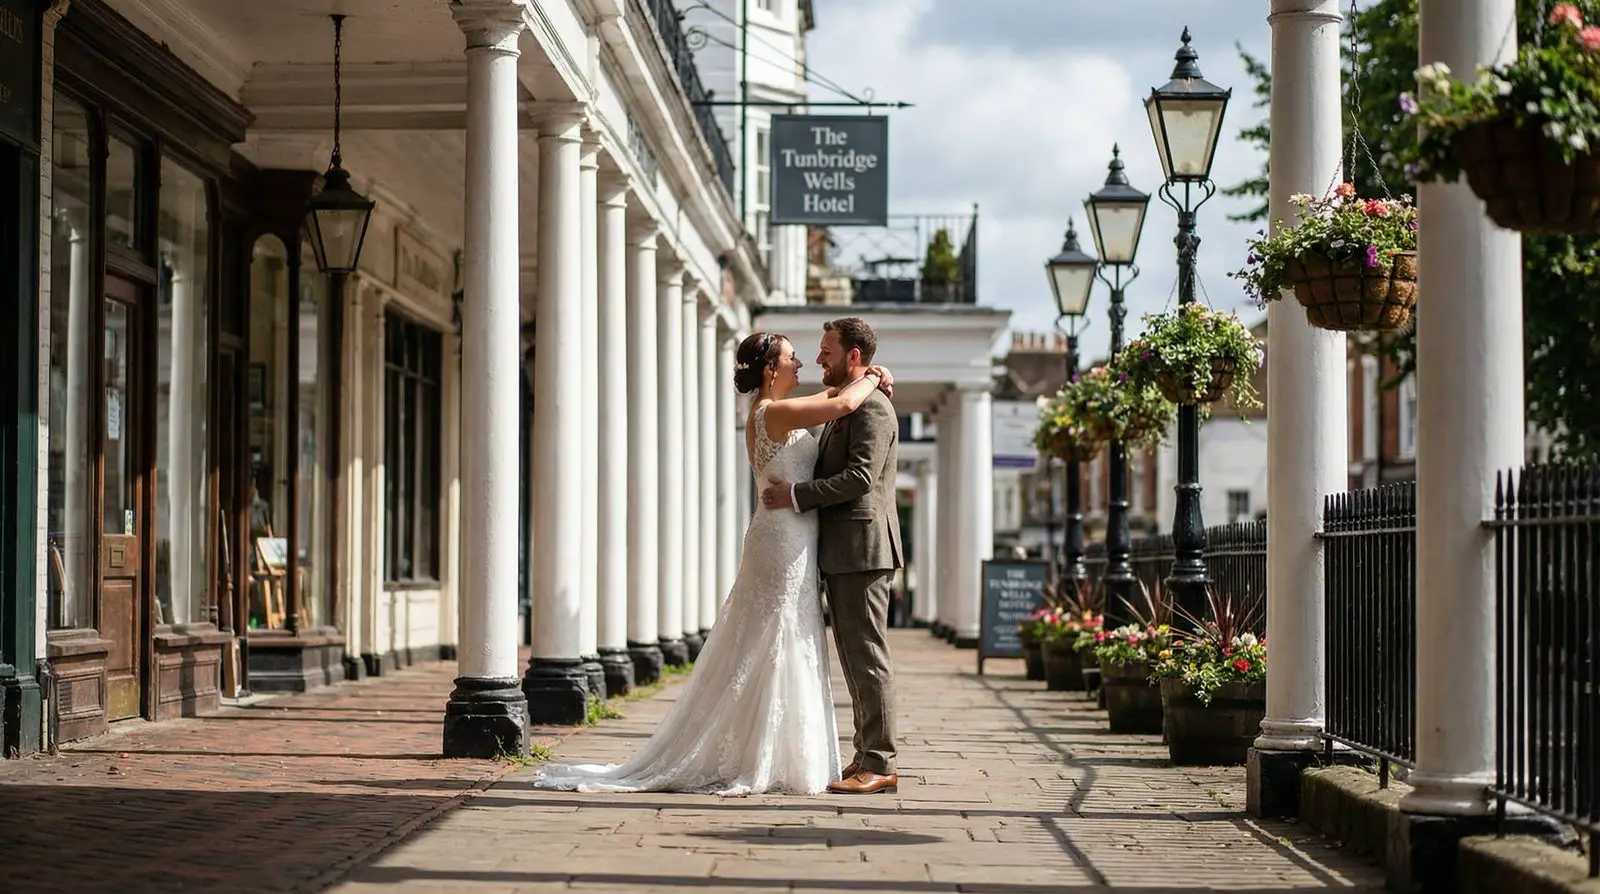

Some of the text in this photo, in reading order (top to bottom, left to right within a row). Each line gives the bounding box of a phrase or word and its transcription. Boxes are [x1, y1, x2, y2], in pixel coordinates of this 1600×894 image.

[810, 126, 848, 146] The
[780, 148, 878, 173] Tunbridge
[803, 171, 856, 191] Wells
[803, 193, 855, 213] Hotel
